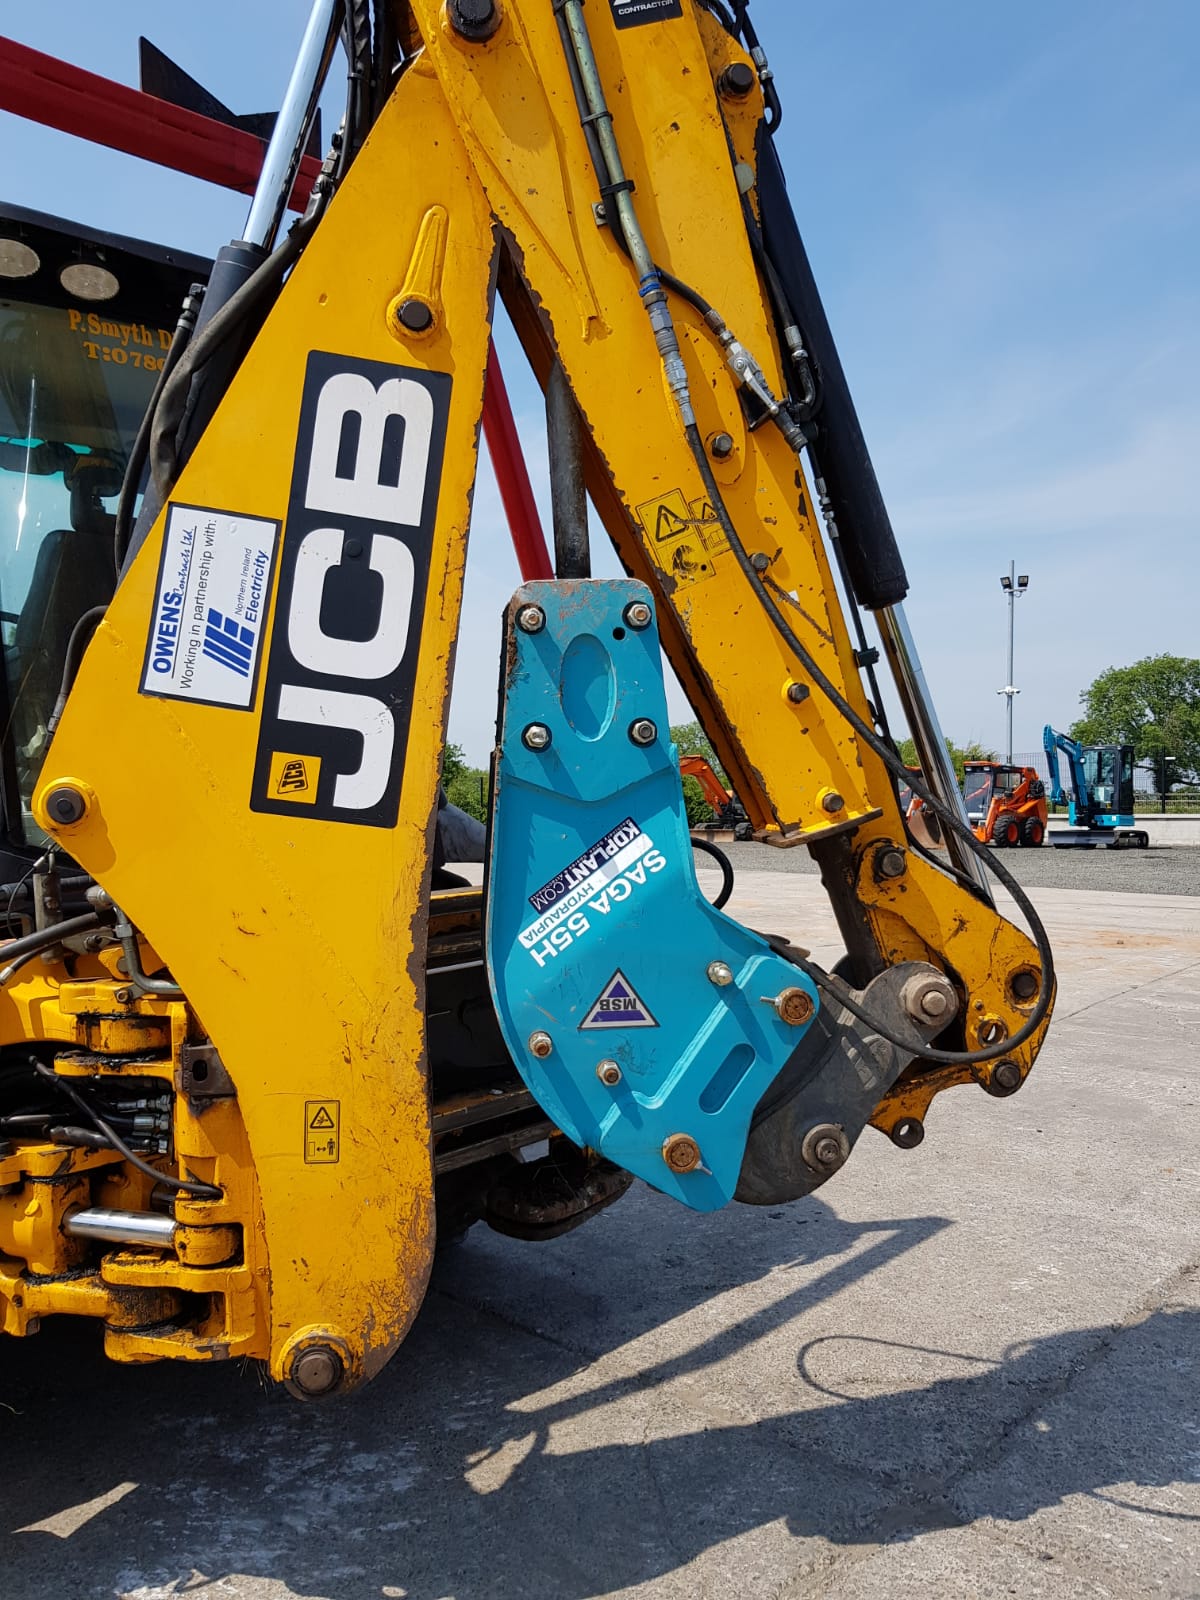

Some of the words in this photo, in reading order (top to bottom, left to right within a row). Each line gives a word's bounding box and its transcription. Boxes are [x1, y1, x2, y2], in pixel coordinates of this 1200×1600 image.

[618, 0, 673, 15] CONTRACTOR
[203, 519, 217, 548] with:
[193, 551, 214, 622] partnership
[241, 547, 252, 576] Ireland
[245, 550, 270, 624] Electricity
[152, 591, 183, 674] OWENS
[173, 547, 191, 597] Contracts
[235, 577, 249, 616] Northern
[277, 373, 434, 810] JCB
[192, 624, 201, 636] in
[180, 637, 201, 689] Working
[282, 762, 305, 789] JCB
[533, 822, 641, 911] KDPLANT.COM
[587, 849, 667, 915] SAGA
[523, 883, 595, 942] HYDRAUPIA
[529, 912, 590, 968] 55H
[600, 998, 638, 1011] MSB
